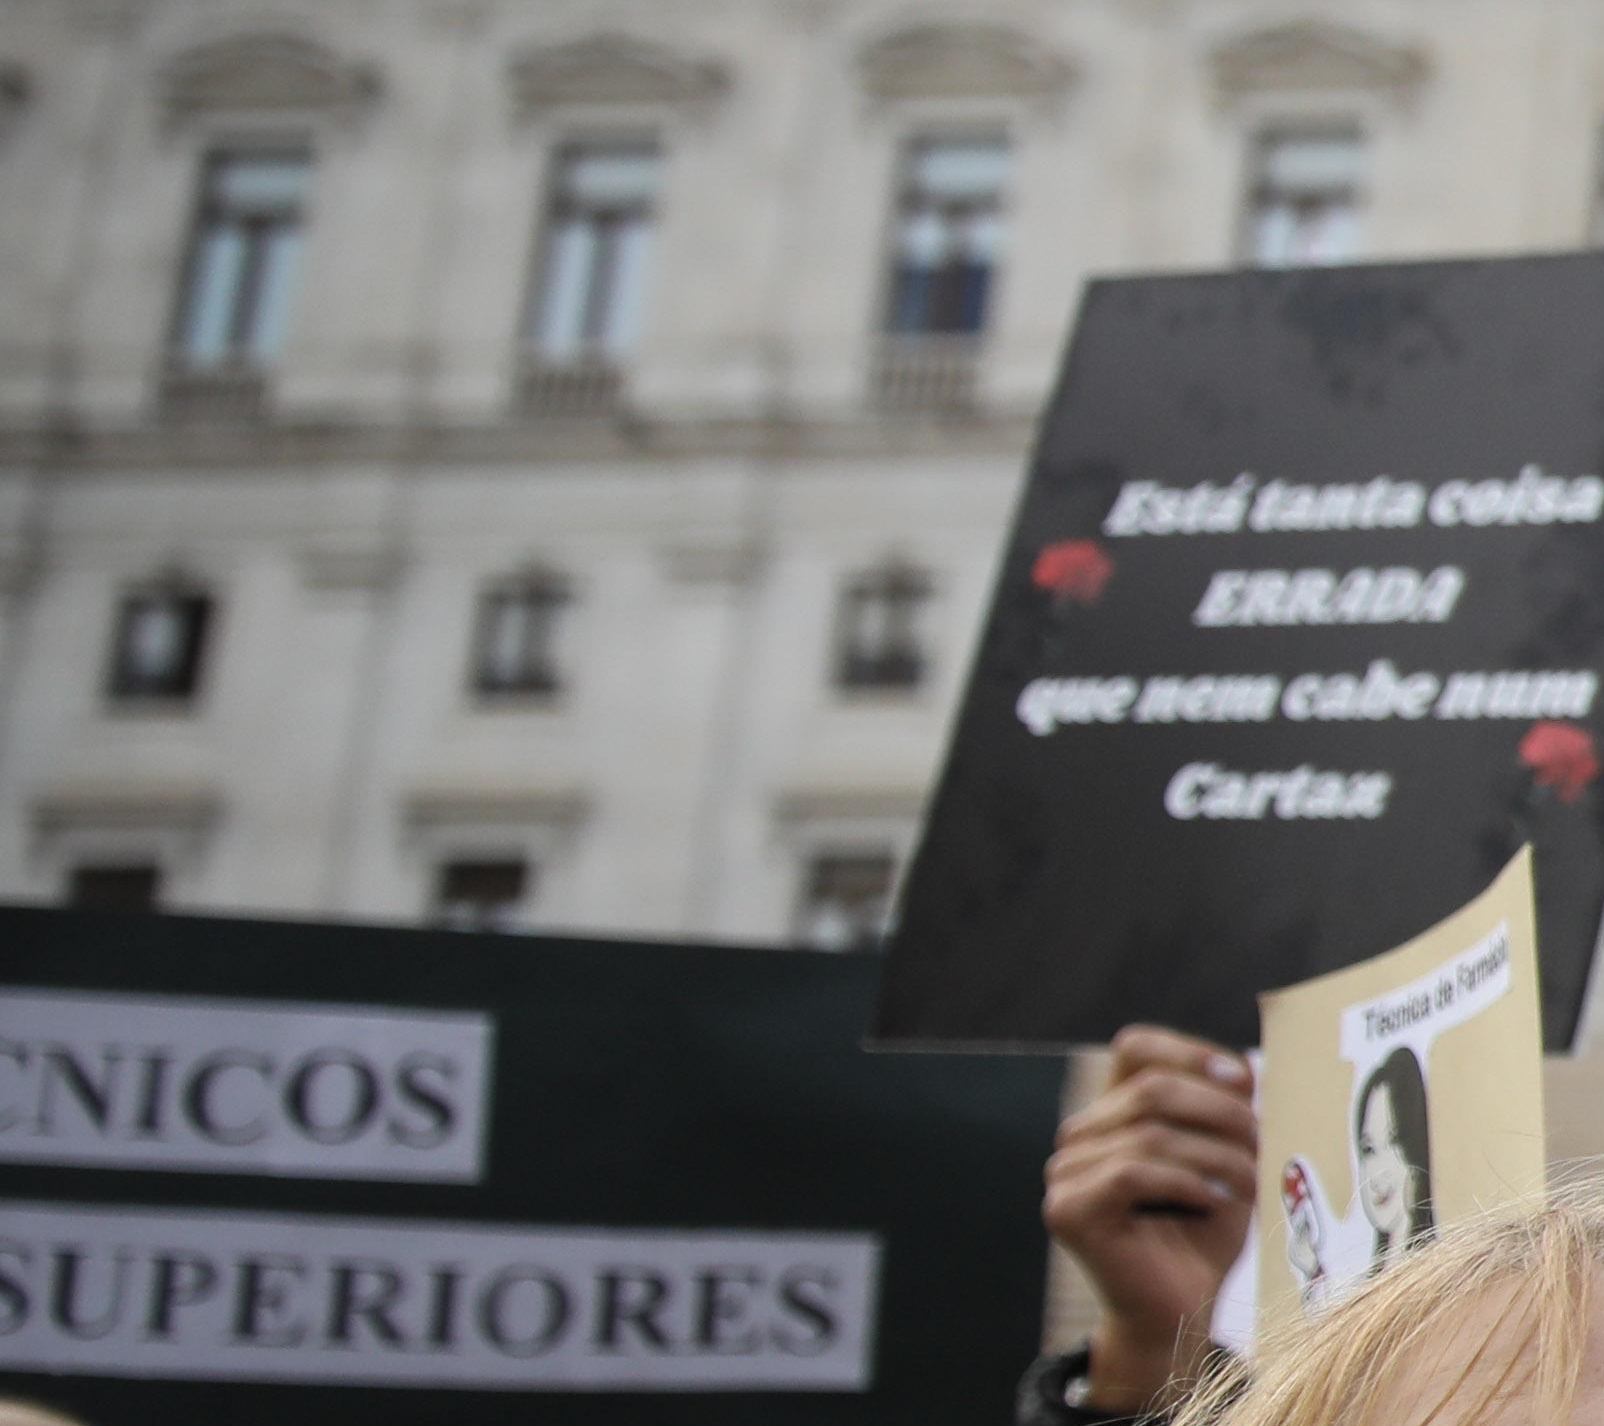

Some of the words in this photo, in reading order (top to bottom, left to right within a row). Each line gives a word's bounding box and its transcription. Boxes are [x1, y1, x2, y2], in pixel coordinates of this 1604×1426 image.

[1104, 473, 1252, 536] Está
[1248, 476, 1425, 532] tanta
[1193, 566, 1465, 627] ERRADA
[1016, 676, 1138, 736] que
[1132, 675, 1280, 723] nem
[1281, 659, 1440, 721] cabe
[1433, 671, 1597, 719] num
